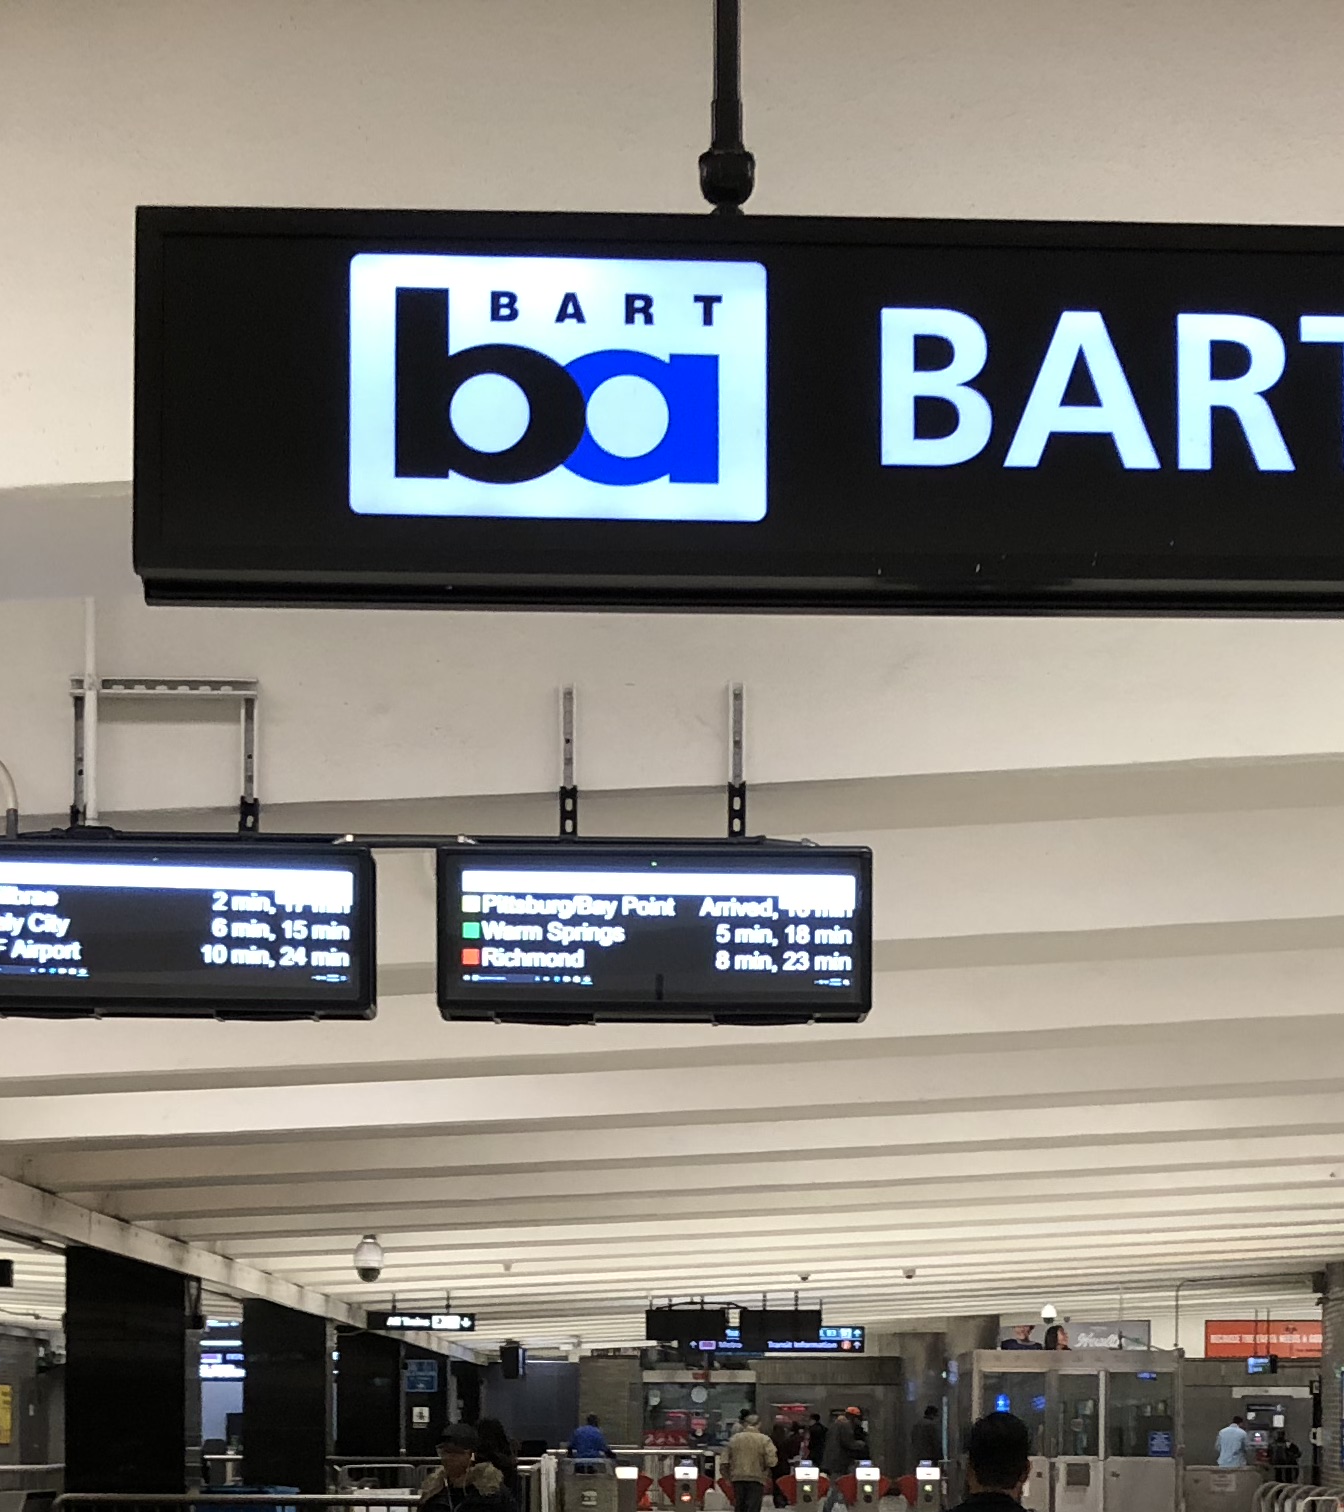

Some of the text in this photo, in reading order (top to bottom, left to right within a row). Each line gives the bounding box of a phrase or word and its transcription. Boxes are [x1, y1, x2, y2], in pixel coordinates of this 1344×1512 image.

[490, 290, 723, 326] BART
[212, 891, 229, 912] 2
[231, 892, 276, 916] min,
[481, 895, 618, 920] Pittsburg/Bay
[621, 896, 676, 918] Point
[699, 896, 778, 920] Arrived,
[27, 912, 71, 937] City
[212, 918, 229, 938] 6
[231, 919, 276, 942] min,
[281, 920, 308, 940] 15
[311, 920, 350, 941] min
[481, 922, 853, 948] Warm Springs 5 min, 18 min
[10, 938, 83, 964] Airport
[201, 944, 227, 965] 10
[231, 945, 276, 968] min,
[279, 946, 308, 966] 24
[311, 946, 350, 967] min
[481, 947, 853, 974] Richmond 8 min, 23 min
